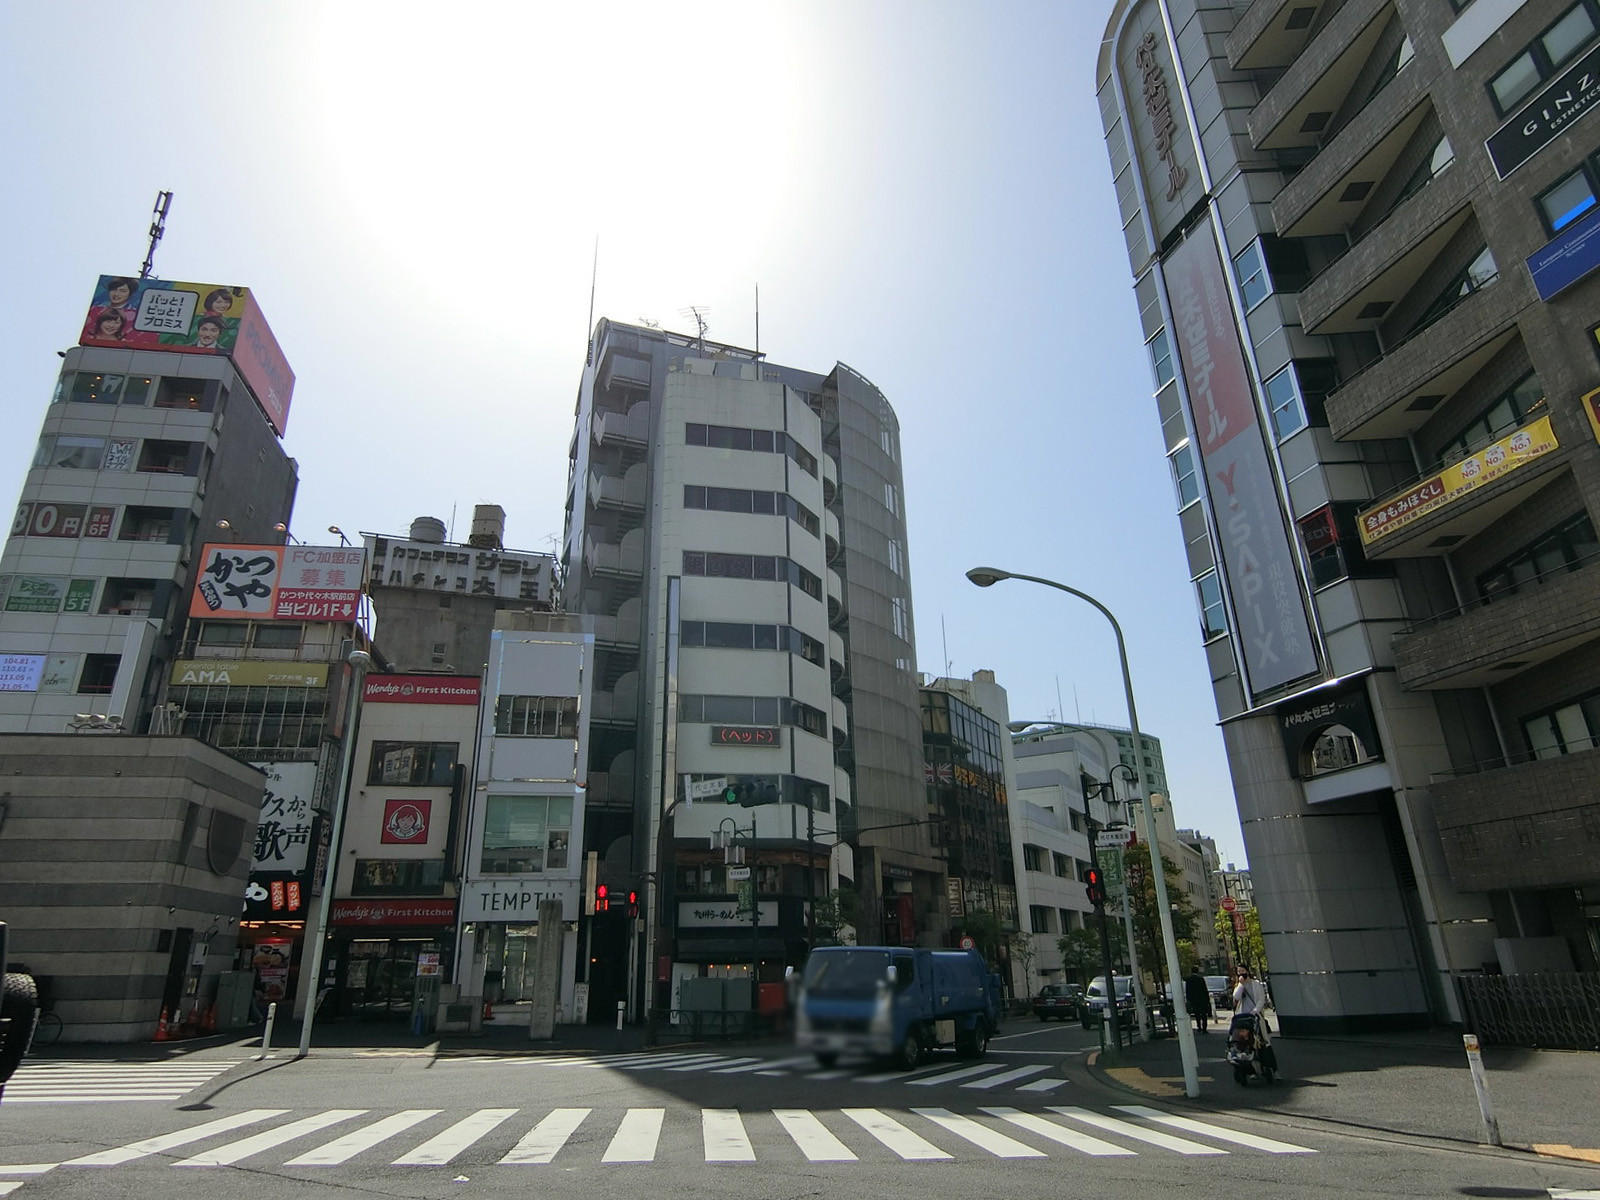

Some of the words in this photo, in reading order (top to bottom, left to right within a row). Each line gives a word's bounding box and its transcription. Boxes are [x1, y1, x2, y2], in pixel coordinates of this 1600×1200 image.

[144, 317, 183, 329] プロミス
[1510, 438, 1531, 453] No.1
[1486, 452, 1505, 467] No.1
[1462, 464, 1481, 479] No.1
[1366, 484, 1441, 530] 全身もみほぐし
[89, 524, 109, 535] 6F
[292, 550, 361, 565] FC加盟店
[393, 545, 470, 566] カフェテラス
[475, 551, 541, 576] サラン
[300, 568, 347, 586] 募集
[279, 590, 356, 601] かつや代々木駅前店
[471, 576, 539, 600] 大王
[66, 599, 91, 611] 5F
[277, 601, 341, 616] 当ビル1F
[181, 671, 231, 683] AMA
[306, 677, 318, 686] 3F
[367, 682, 400, 695] Wendy's
[416, 686, 439, 694] First
[440, 686, 477, 695] Kitchen
[948, 881, 962, 914] HAIR
[333, 906, 369, 920] Wendy's
[387, 908, 412, 916] First
[414, 907, 454, 917] Kitchen
